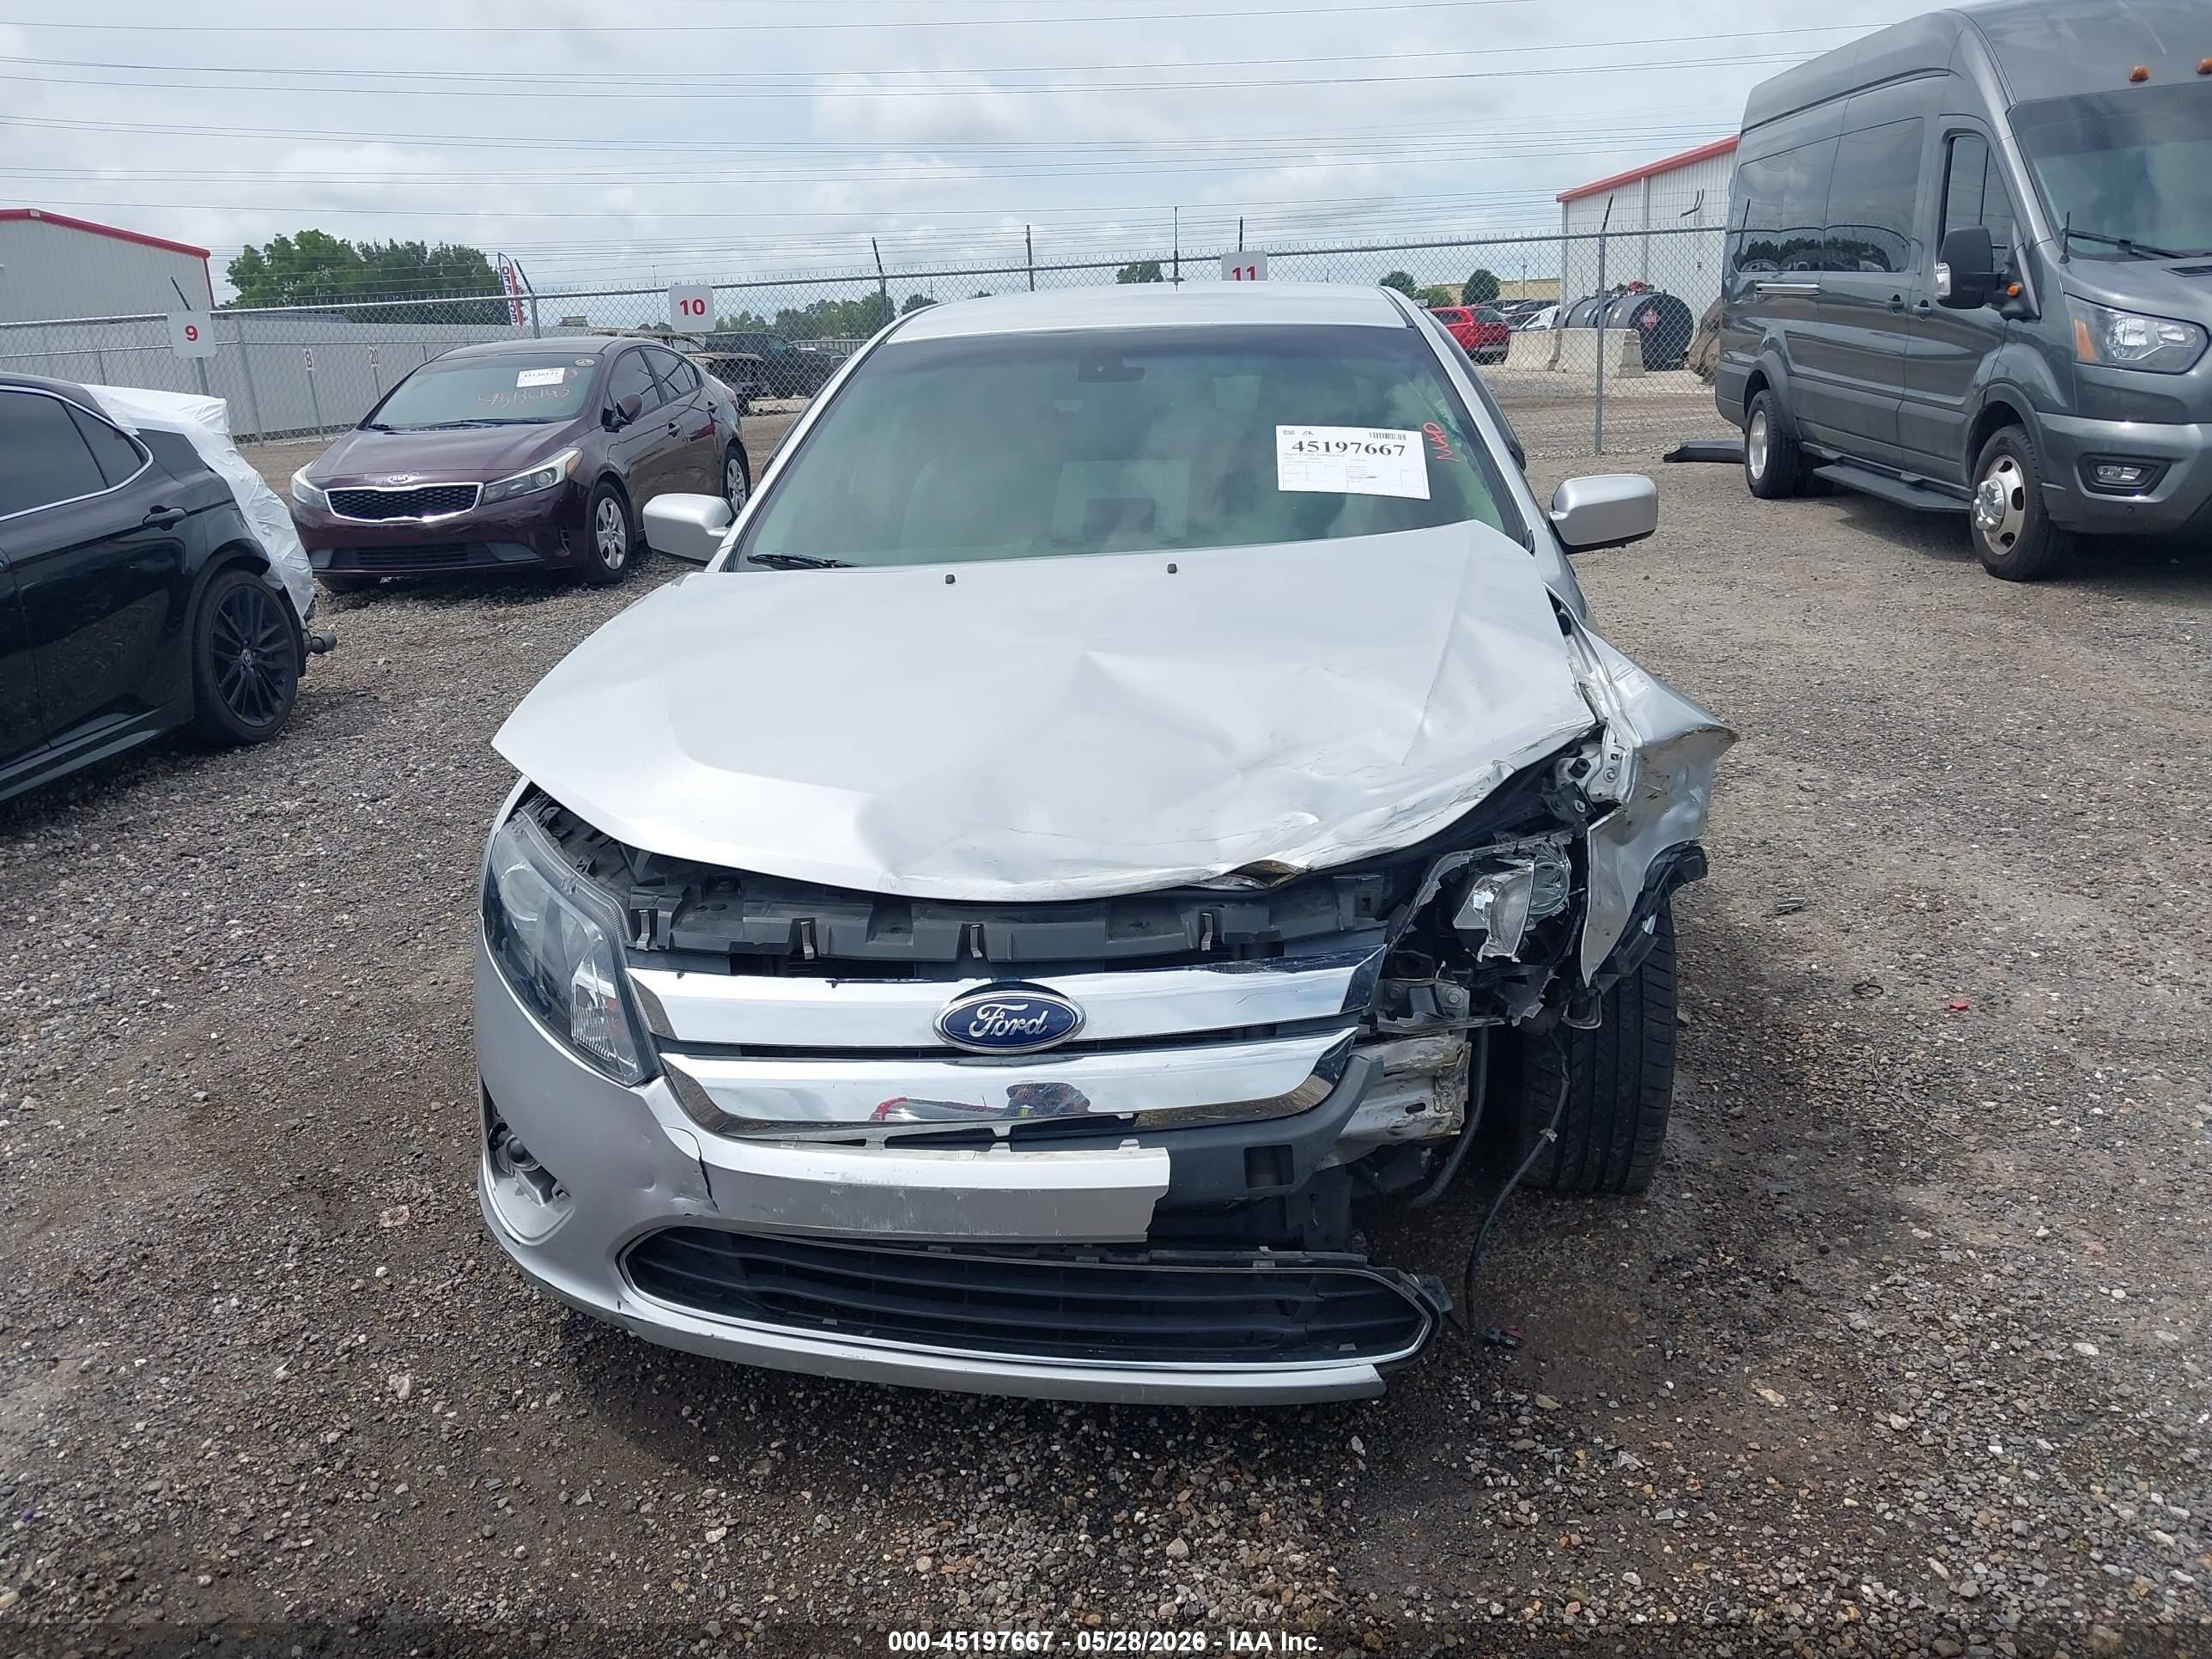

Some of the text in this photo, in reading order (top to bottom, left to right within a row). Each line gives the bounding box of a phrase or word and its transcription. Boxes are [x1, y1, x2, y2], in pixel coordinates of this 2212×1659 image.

[1231, 265, 1255, 282] 11
[502, 266, 518, 323] OFFCE
[679, 299, 706, 316] 10
[185, 325, 198, 342] 9
[1291, 440, 1406, 457] 45197667
[969, 1003, 1049, 1037] Ford
